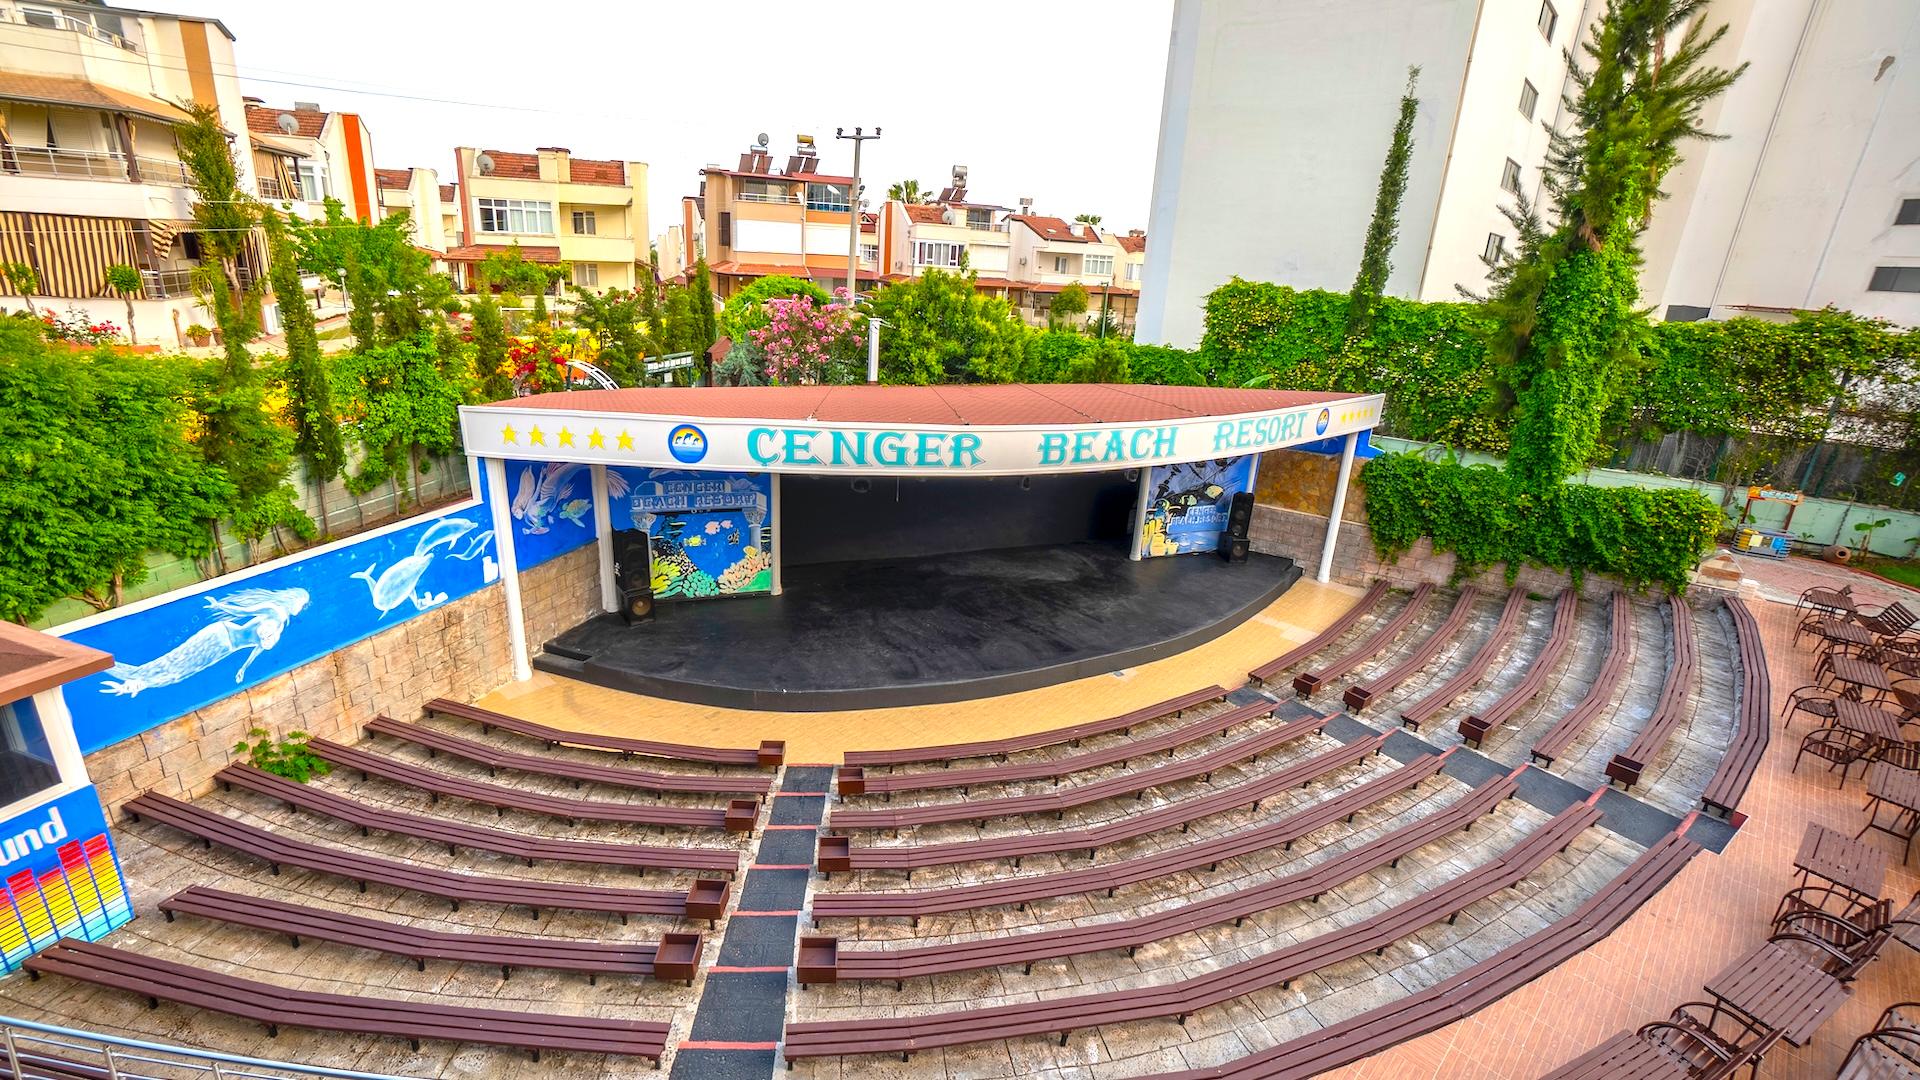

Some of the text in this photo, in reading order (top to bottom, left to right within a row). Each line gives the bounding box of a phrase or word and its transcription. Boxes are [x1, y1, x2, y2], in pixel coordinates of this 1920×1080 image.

[1038, 426, 1179, 465] BEACH
[1212, 412, 1309, 451] RESORT
[631, 493, 756, 509] BEACH RESORT
